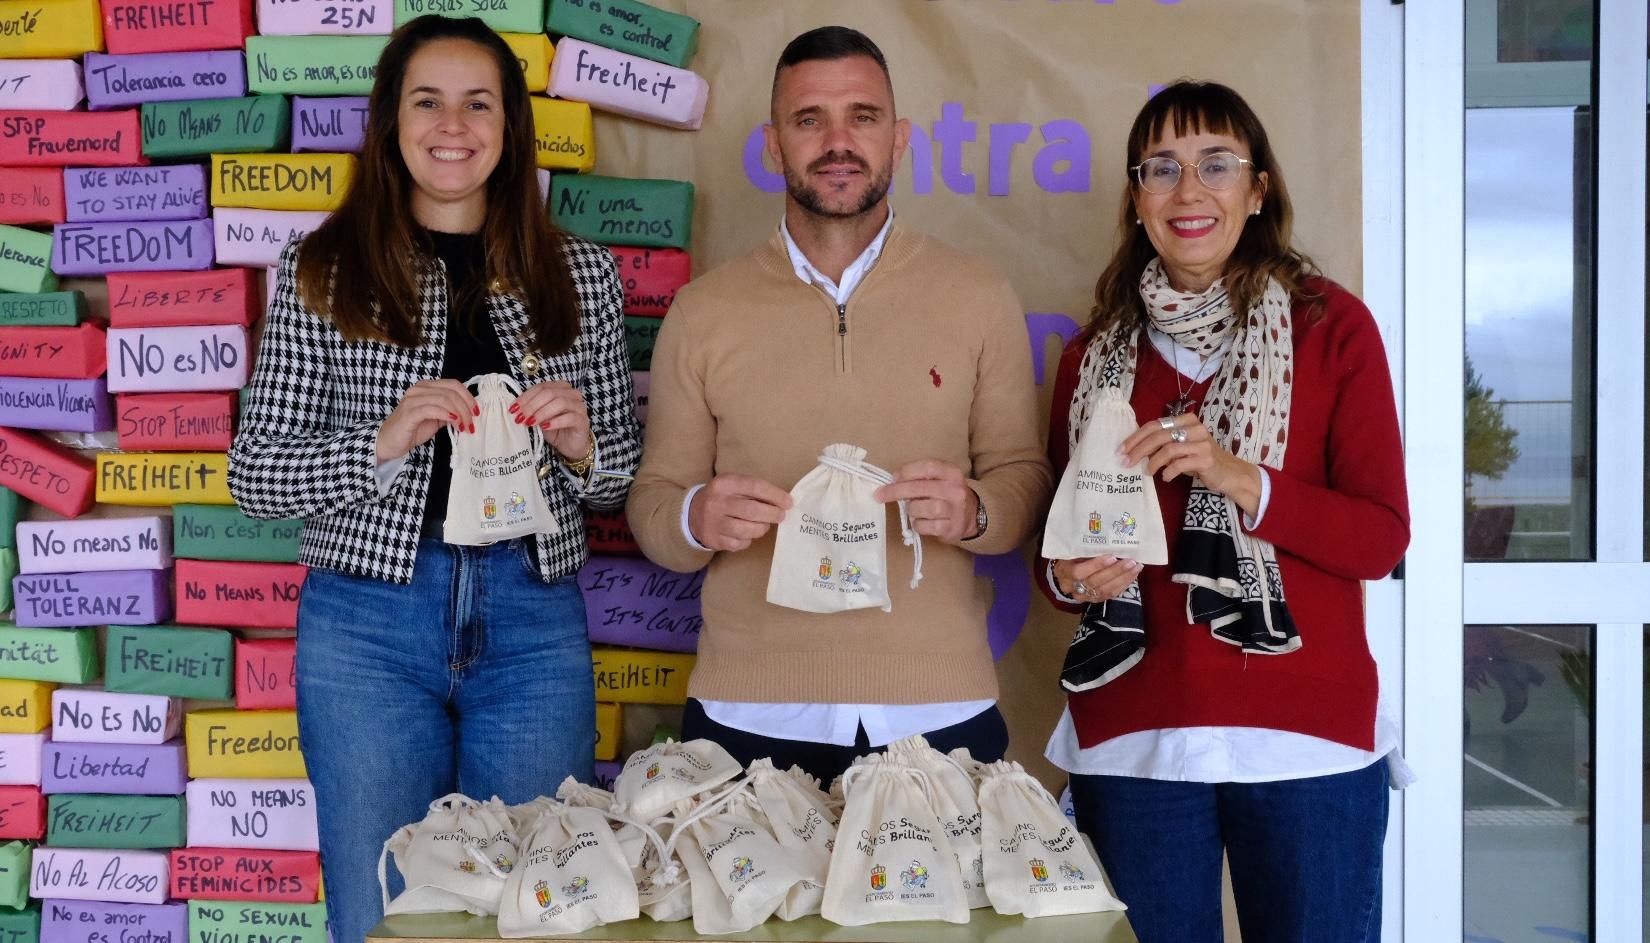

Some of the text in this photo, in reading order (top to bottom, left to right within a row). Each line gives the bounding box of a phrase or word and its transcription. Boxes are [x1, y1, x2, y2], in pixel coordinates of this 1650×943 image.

[320, 5, 376, 28] 25N
[91, 64, 227, 94] Tolerancia cero
[79, 169, 171, 190] WE WANT
[220, 160, 333, 195] FREEDOM
[77, 199, 106, 215] TO
[116, 191, 157, 210] STAY
[559, 187, 643, 217] Ni una
[226, 222, 255, 243] NO
[261, 228, 281, 243] AL
[600, 219, 673, 239] menos
[60, 225, 193, 265] FREEDOM
[173, 352, 197, 374] es
[832, 532, 879, 543] Brillantes
[841, 521, 876, 534] Seguros
[73, 534, 132, 553] means
[18, 578, 79, 595] NULL
[26, 595, 141, 618] TOLERANZ
[53, 751, 150, 780] Libertad
[210, 789, 307, 809] NO MEANS
[231, 811, 268, 838] NO
[177, 856, 273, 875] STOP AUX
[79, 909, 97, 922] es
[104, 911, 147, 926] amor
[199, 907, 312, 928] NO SEXUAL
